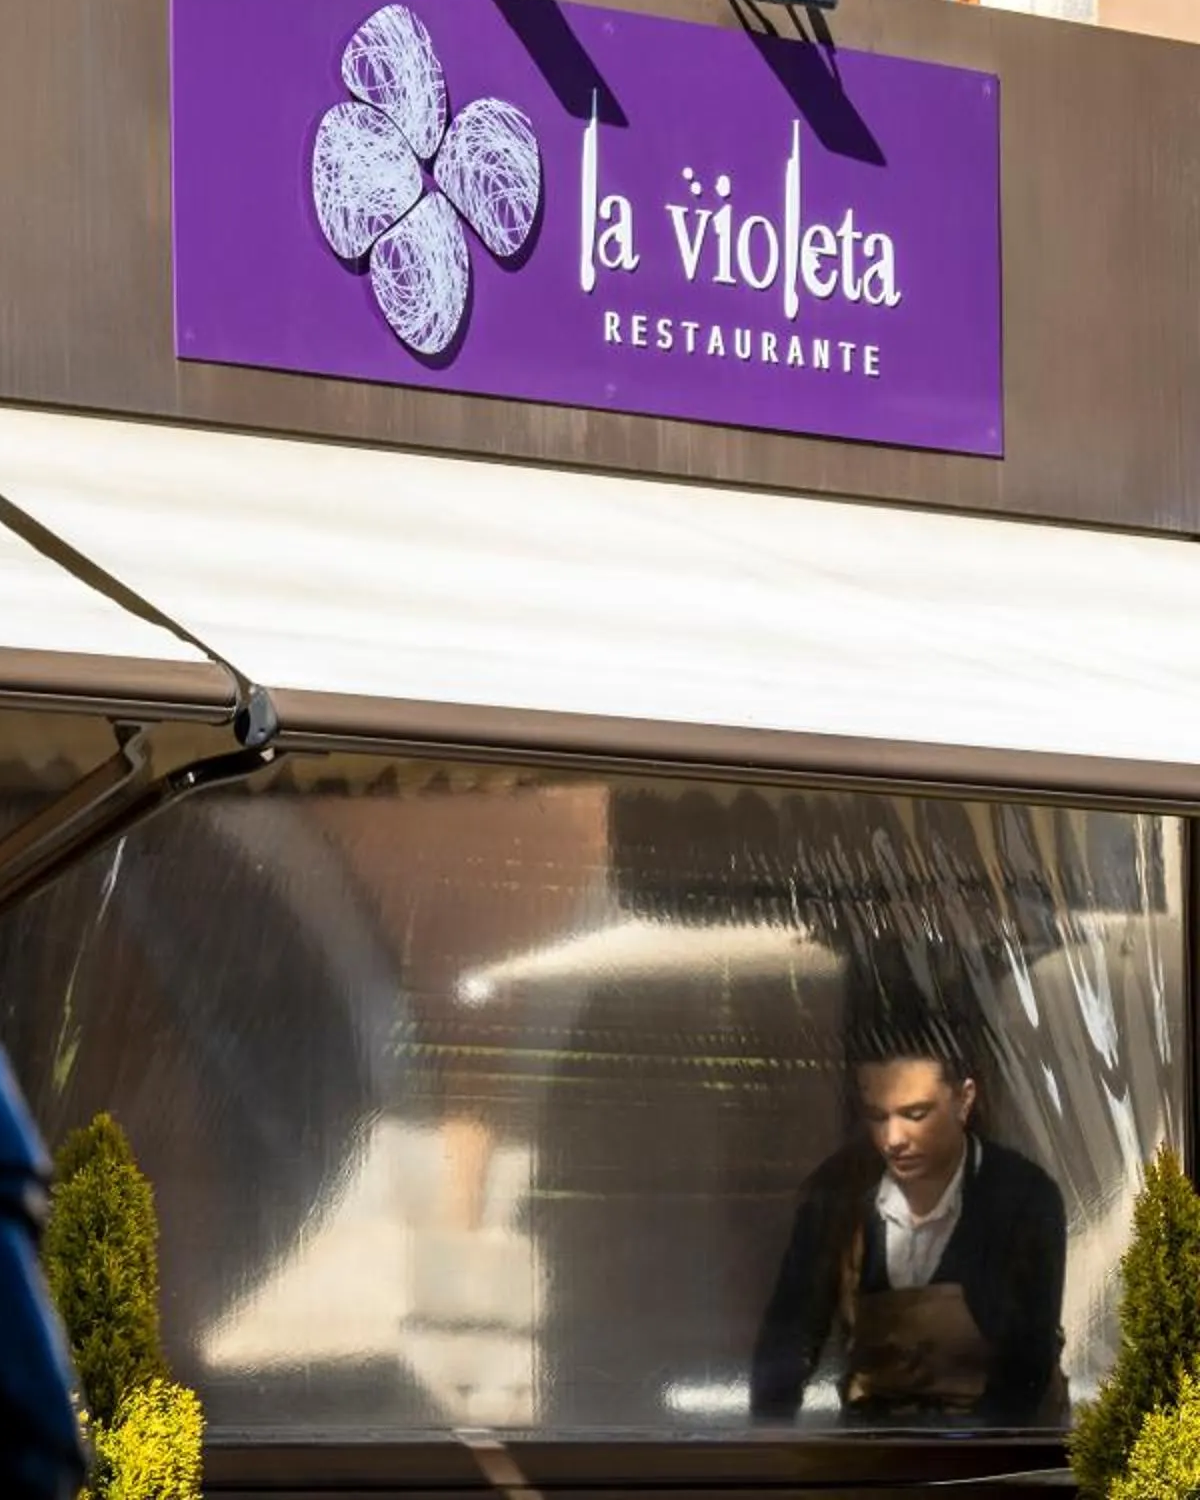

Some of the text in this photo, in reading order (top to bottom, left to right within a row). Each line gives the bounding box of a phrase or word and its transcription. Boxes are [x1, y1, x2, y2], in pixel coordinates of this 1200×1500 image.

[581, 88, 901, 319] la violeta
[605, 311, 880, 376] RESTAURANTE
